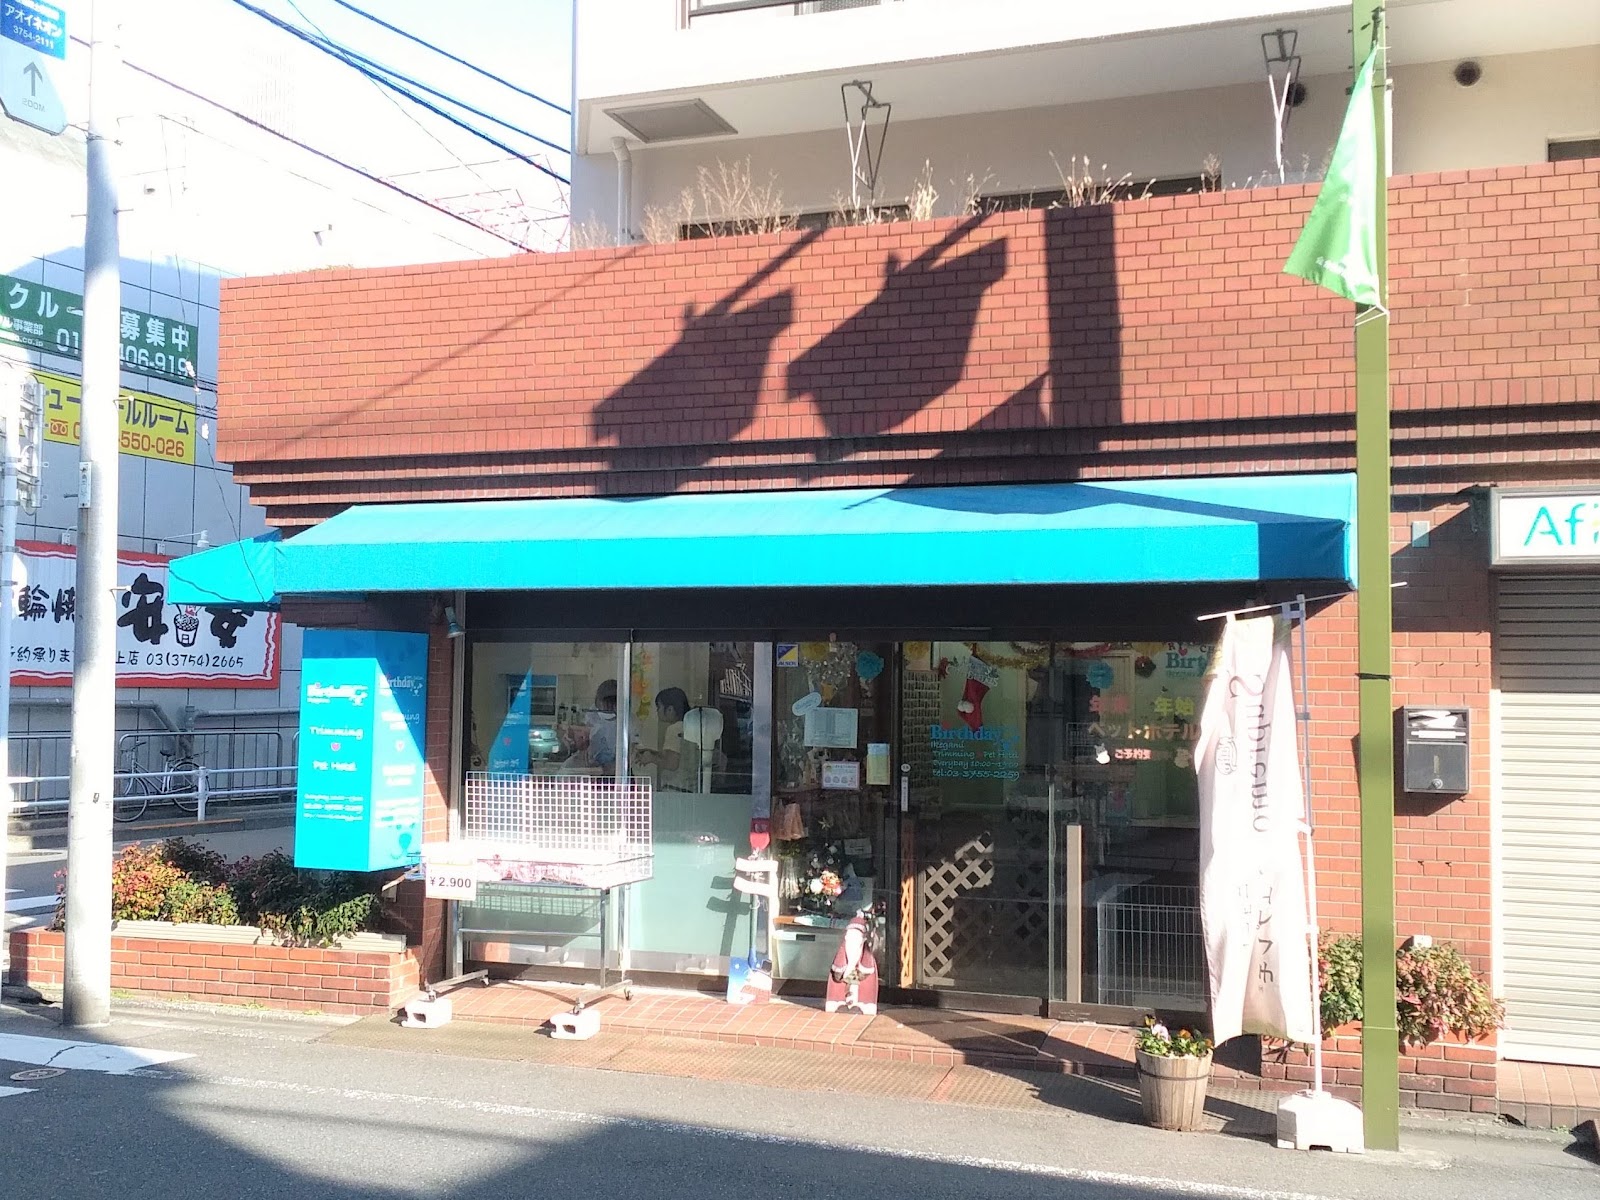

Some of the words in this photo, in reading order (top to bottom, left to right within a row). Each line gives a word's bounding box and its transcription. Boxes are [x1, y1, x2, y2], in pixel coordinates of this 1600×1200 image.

[4, 3, 63, 38] アオイネオン
[13, 25, 54, 49] 3754-2111
[11, 645, 75, 664] 約承りま
